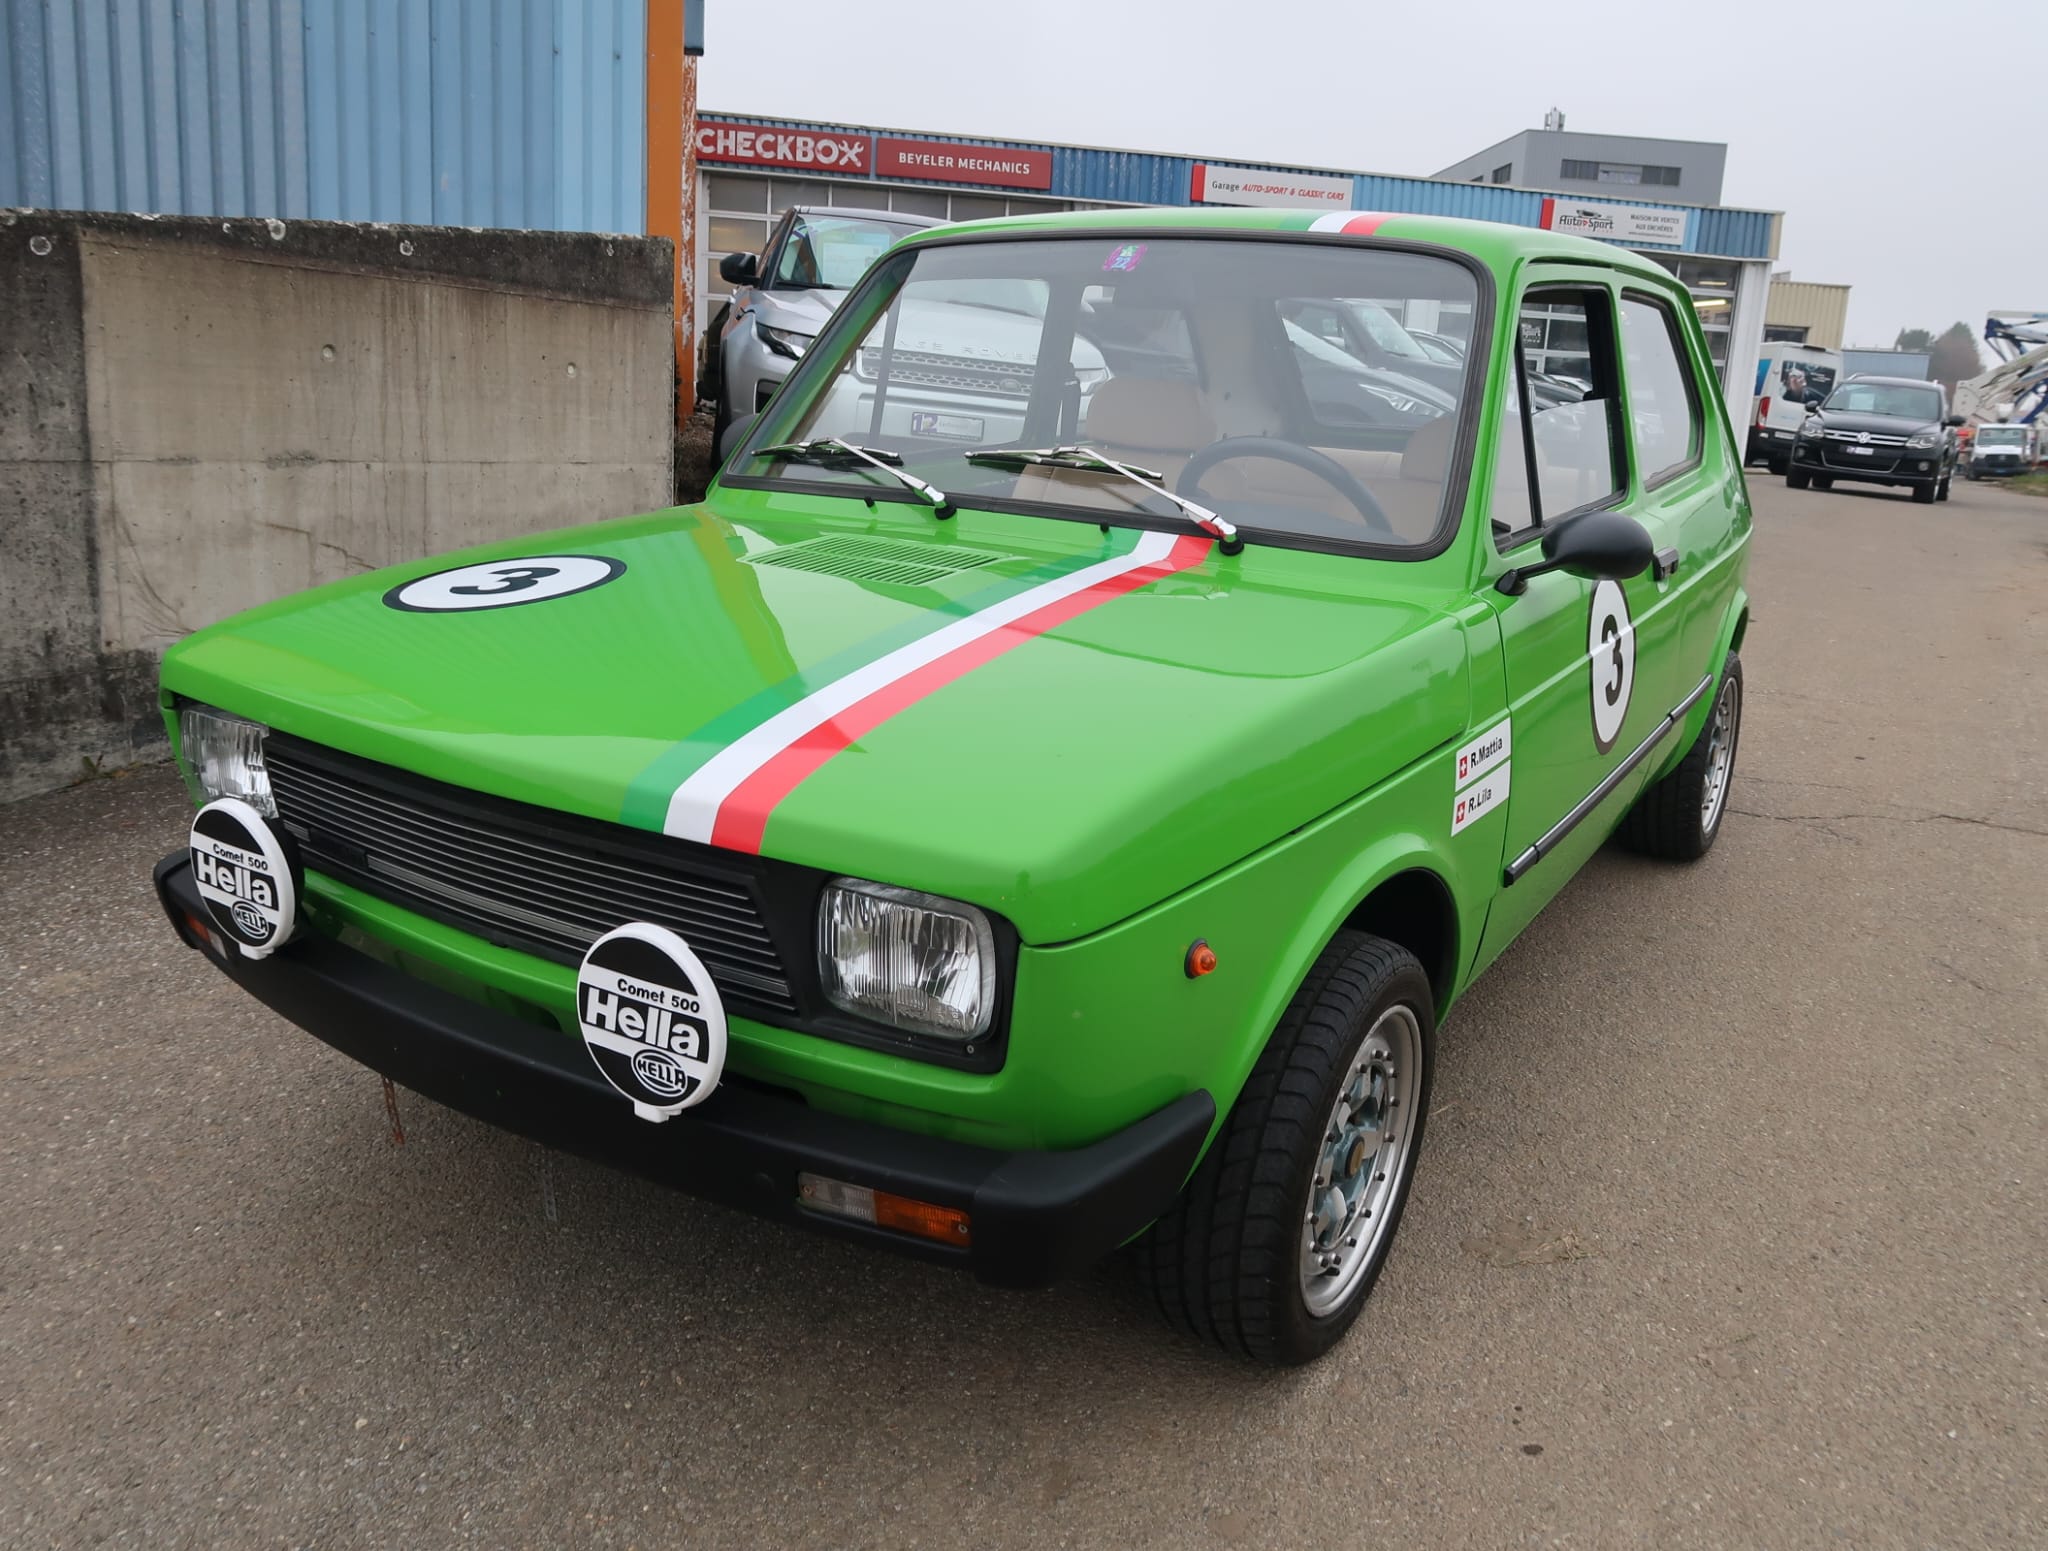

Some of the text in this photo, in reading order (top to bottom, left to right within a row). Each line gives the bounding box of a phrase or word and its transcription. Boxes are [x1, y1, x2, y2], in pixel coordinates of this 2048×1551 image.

[695, 127, 864, 168] CHECKBOX
[898, 152, 1031, 175] BEYELER MECHANICS
[1212, 181, 1240, 193] Garage
[1242, 184, 1288, 196] AUTO-SPORT
[1298, 189, 1324, 199] CLASSIC
[1327, 191, 1345, 201] CARS
[449, 566, 561, 595] 3
[1601, 614, 1624, 707] 3
[1470, 736, 1503, 769] R.Mattia
[1468, 787, 1492, 815] R.Lila
[213, 843, 269, 871] Comet 500
[197, 851, 272, 908] Hella
[235, 909, 268, 933] HELLA
[617, 978, 700, 1014] Comet 500
[586, 987, 700, 1059] Hella
[637, 1058, 686, 1089] HELLA
